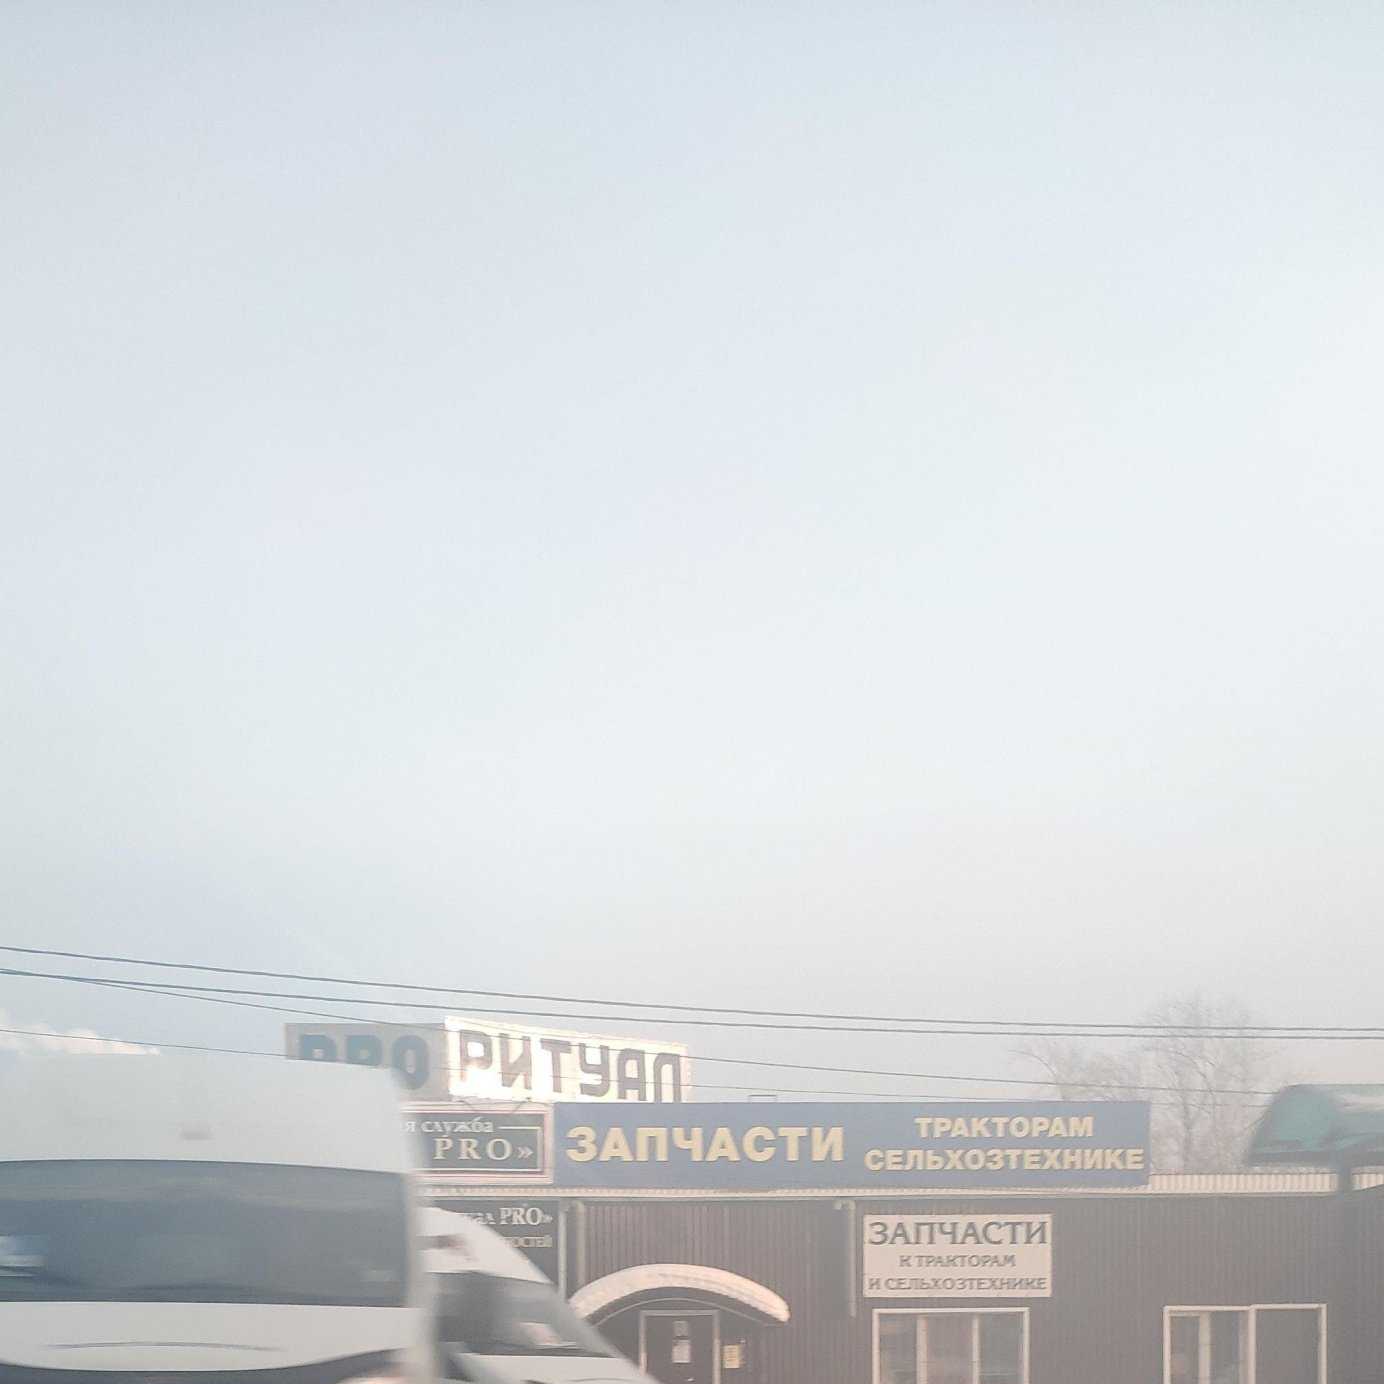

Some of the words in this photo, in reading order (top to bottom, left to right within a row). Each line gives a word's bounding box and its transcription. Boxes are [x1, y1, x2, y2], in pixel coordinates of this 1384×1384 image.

[458, 1029, 682, 1103] РИТУАЛ
[421, 1116, 494, 1136] служба
[915, 1116, 1095, 1138] ТРАКТОРАМ
[565, 1126, 845, 1163] ЗАПЧАСТИ
[864, 1148, 1145, 1171] СЕЛЬХОЗТЕХНИКЕ
[868, 1220, 1048, 1246] ЗАПЧАСТИ
[899, 1255, 913, 1268] К
[915, 1254, 1017, 1268] ТРАКТОРАМ
[868, 1278, 881, 1291] И
[884, 1277, 1047, 1291] СЕЛЬХОЗТЕХНИКЕ
